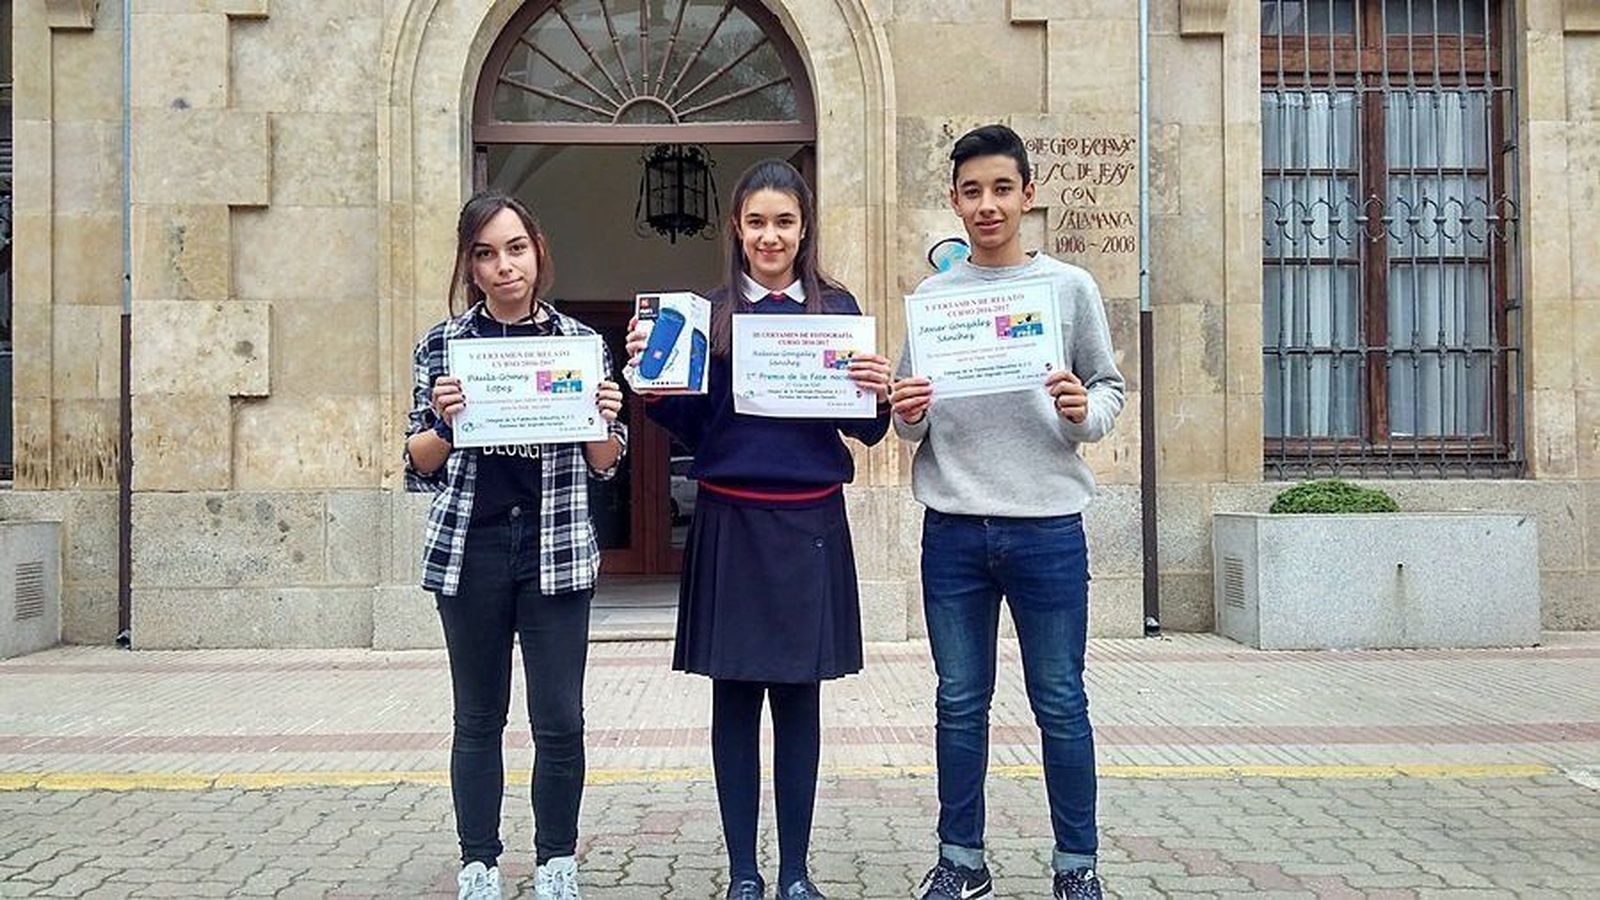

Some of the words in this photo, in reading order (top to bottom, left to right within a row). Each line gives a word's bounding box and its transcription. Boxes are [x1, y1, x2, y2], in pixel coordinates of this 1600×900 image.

[1077, 162, 1092, 181] DE
[1061, 187, 1096, 206] CON
[1052, 209, 1134, 232] SALAMANCA
[1055, 236, 1086, 254] 1908
[1101, 236, 1136, 254] 2008
[931, 299, 977, 310] CERTAMEN
[990, 293, 1026, 303] RELATO
[946, 308, 976, 318] CURSO
[475, 351, 523, 360] CERTAMEN
[537, 349, 570, 358] RELATO
[467, 373, 496, 383] Paula
[759, 372, 785, 381] Premio
